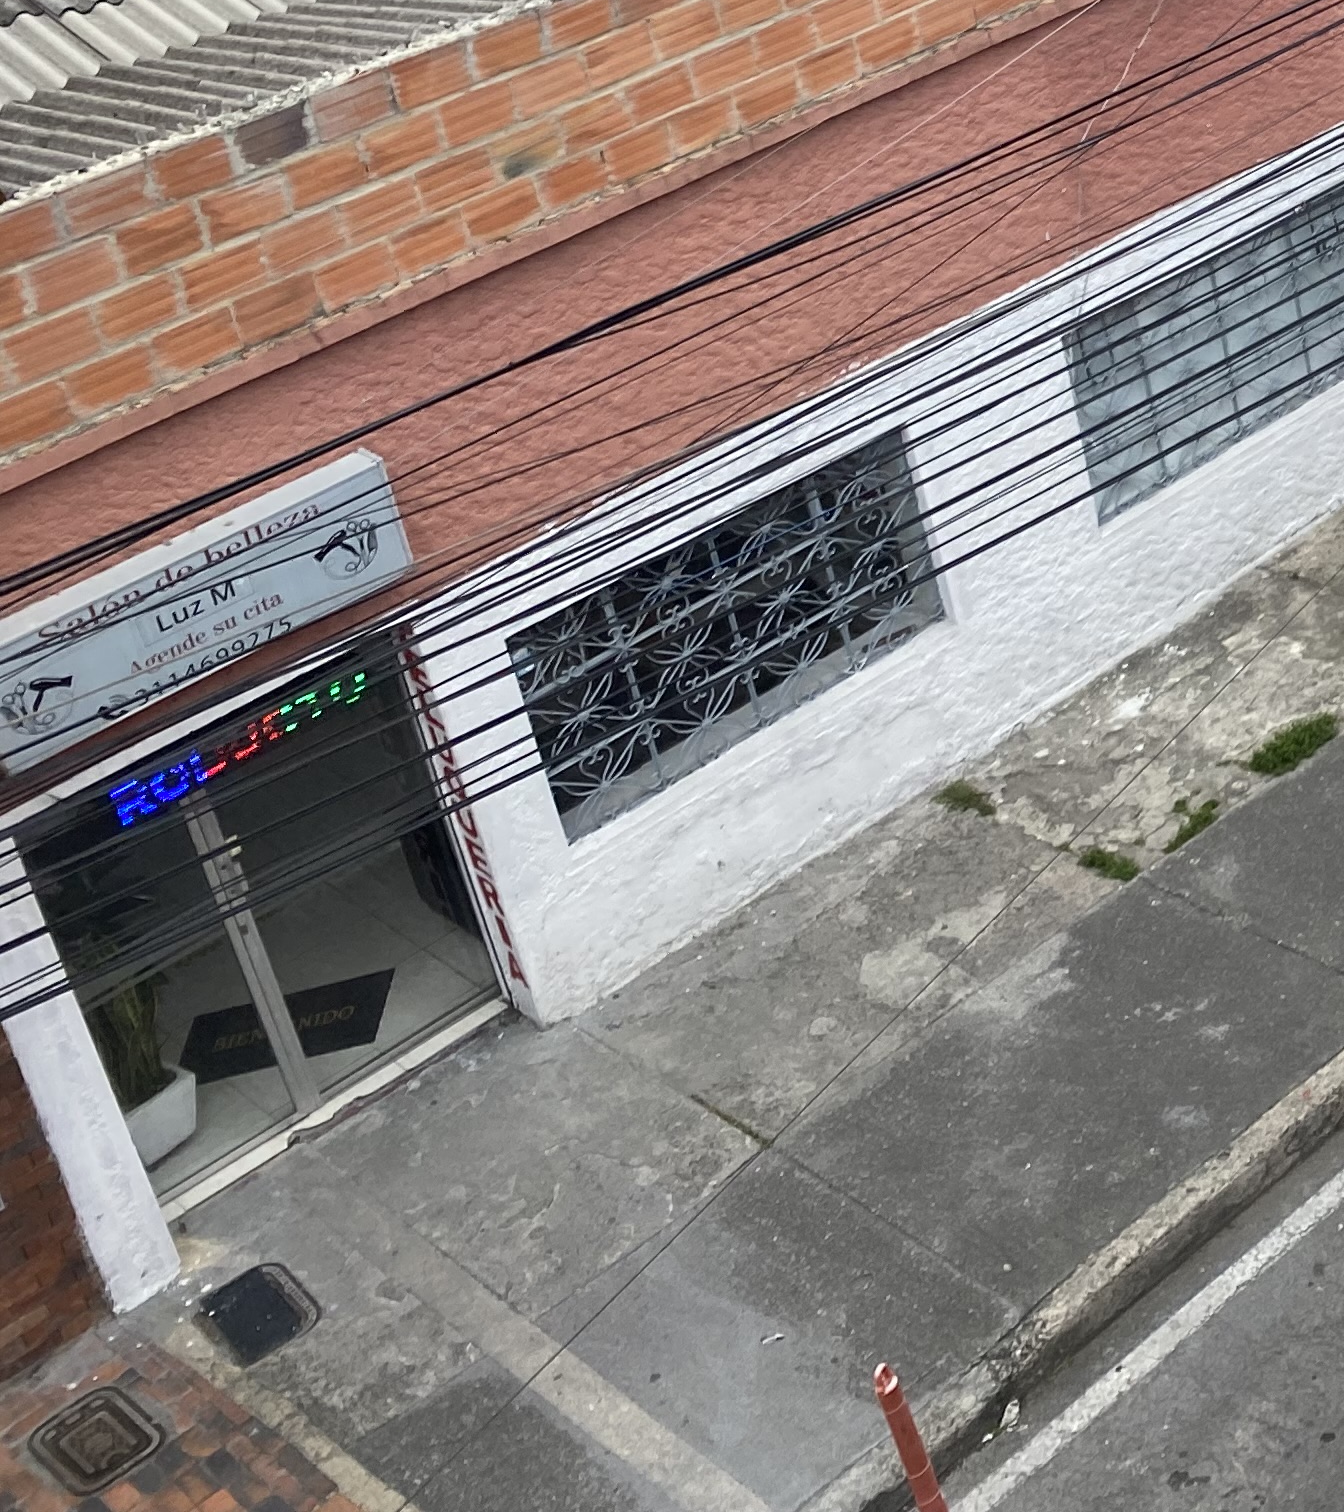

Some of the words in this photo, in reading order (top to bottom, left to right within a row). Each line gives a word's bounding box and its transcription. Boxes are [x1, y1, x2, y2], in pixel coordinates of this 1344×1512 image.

[155, 565, 194, 592] de
[203, 503, 322, 565] belleza
[130, 630, 207, 676] Agende
[213, 615, 238, 637] su
[243, 591, 284, 621] cita
[155, 599, 204, 634] Luz
[210, 580, 237, 606] M
[212, 1004, 357, 1054] BIENNIDO
